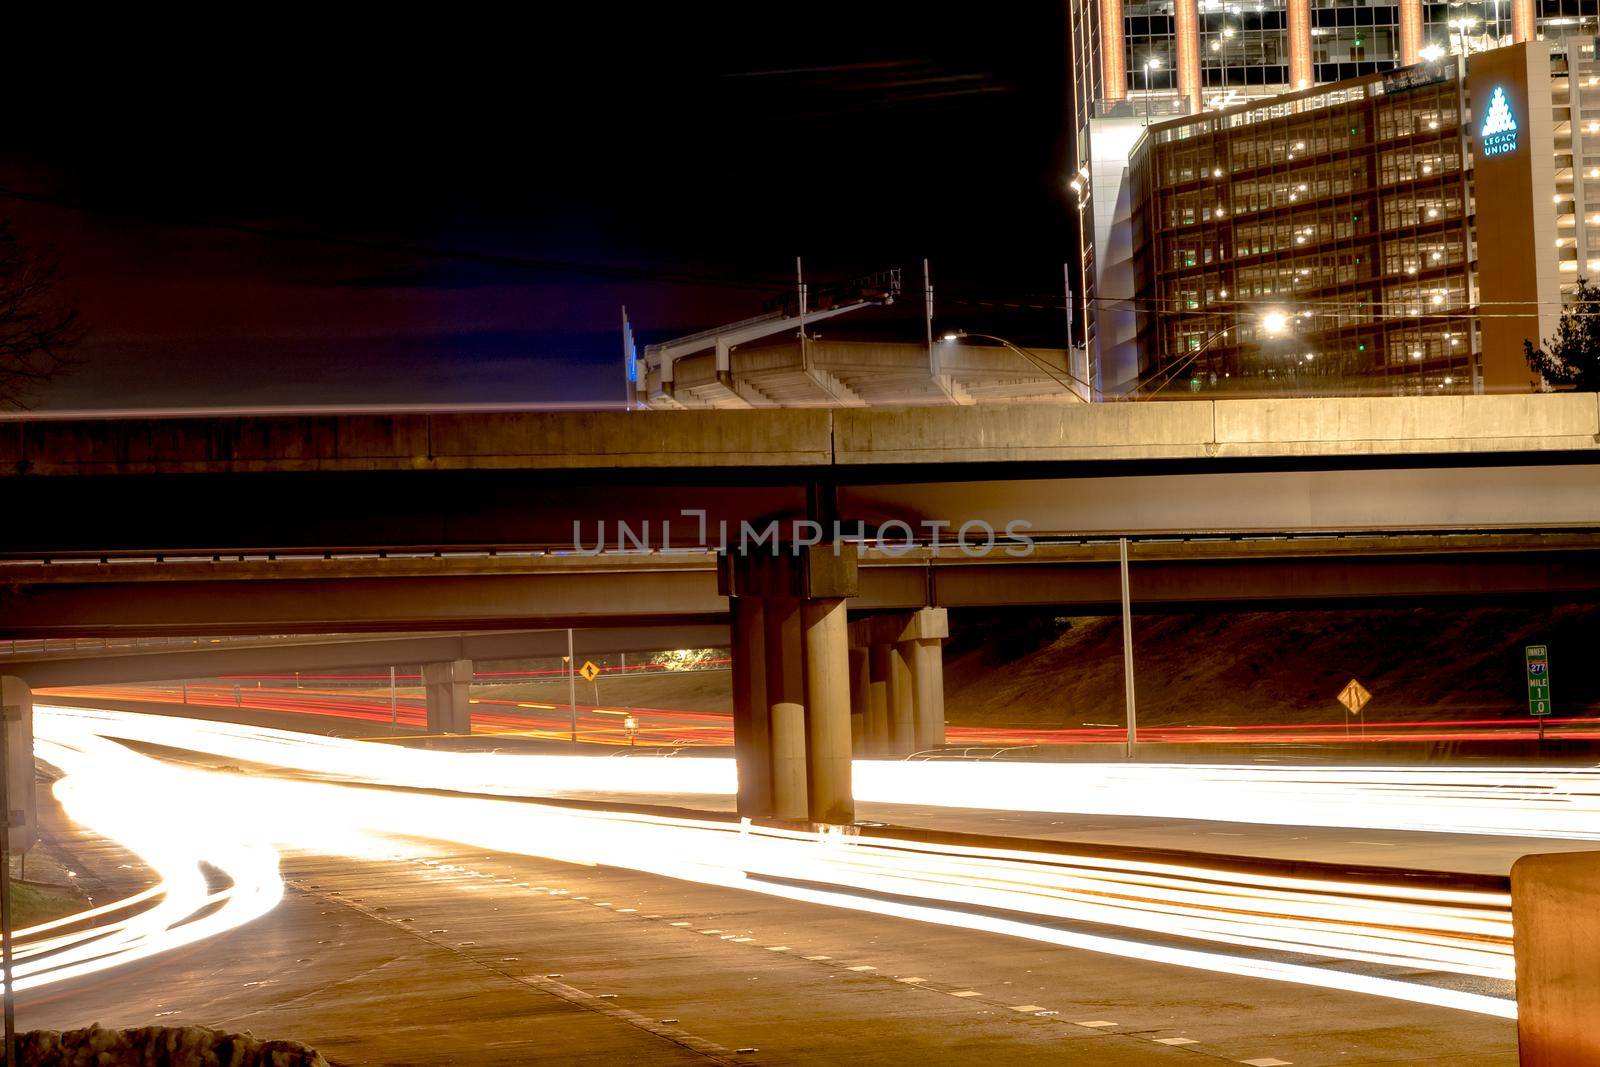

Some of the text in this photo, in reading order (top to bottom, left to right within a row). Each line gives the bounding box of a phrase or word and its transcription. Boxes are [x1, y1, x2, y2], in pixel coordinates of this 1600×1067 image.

[1484, 133, 1516, 146] LEGACY
[1485, 142, 1516, 156] UNION
[1528, 647, 1545, 657] INNER
[1531, 664, 1546, 672] 277
[1530, 679, 1547, 687] MILE
[1537, 688, 1542, 698] 1
